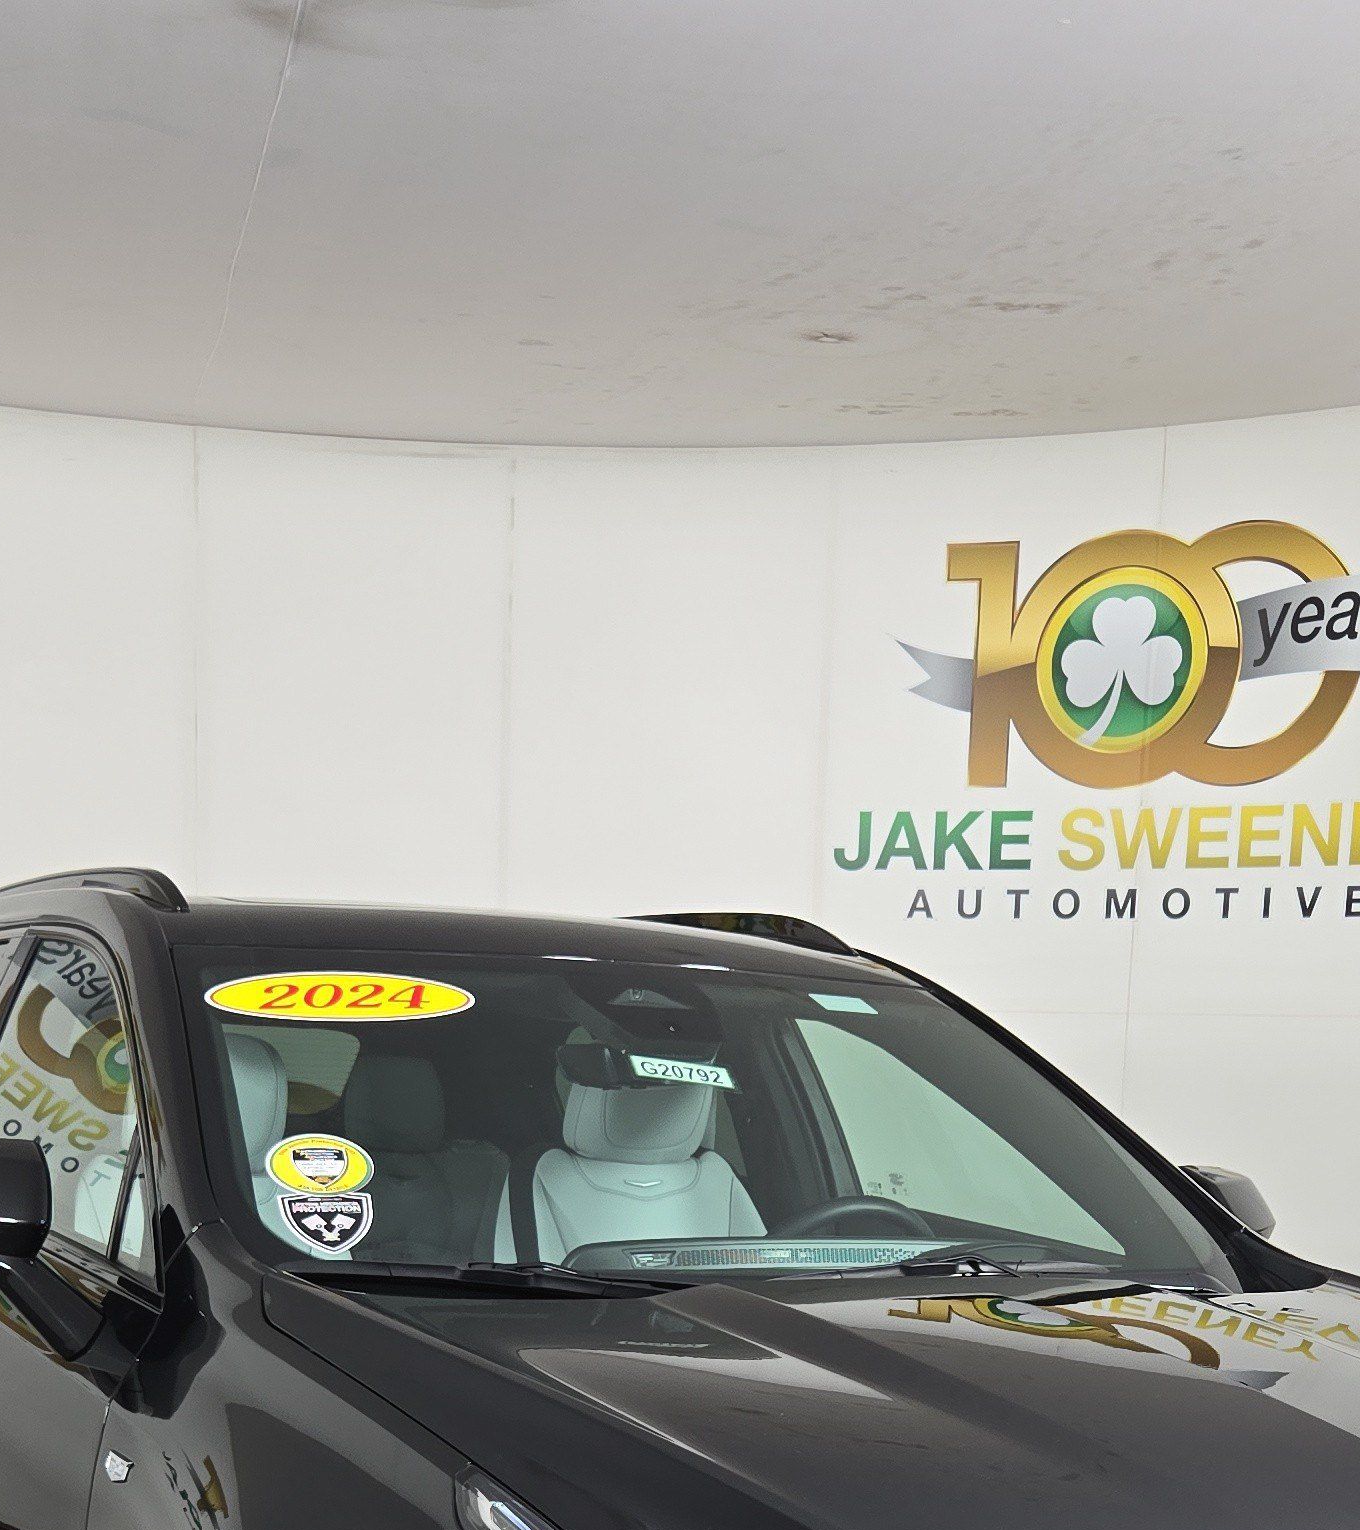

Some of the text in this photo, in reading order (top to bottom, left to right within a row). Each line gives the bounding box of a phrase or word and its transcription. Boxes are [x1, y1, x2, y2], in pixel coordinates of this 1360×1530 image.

[947, 520, 1360, 789] 100
[833, 809, 1034, 871] JAKE
[259, 983, 430, 1009] 2024
[640, 1061, 724, 1084] G20792
